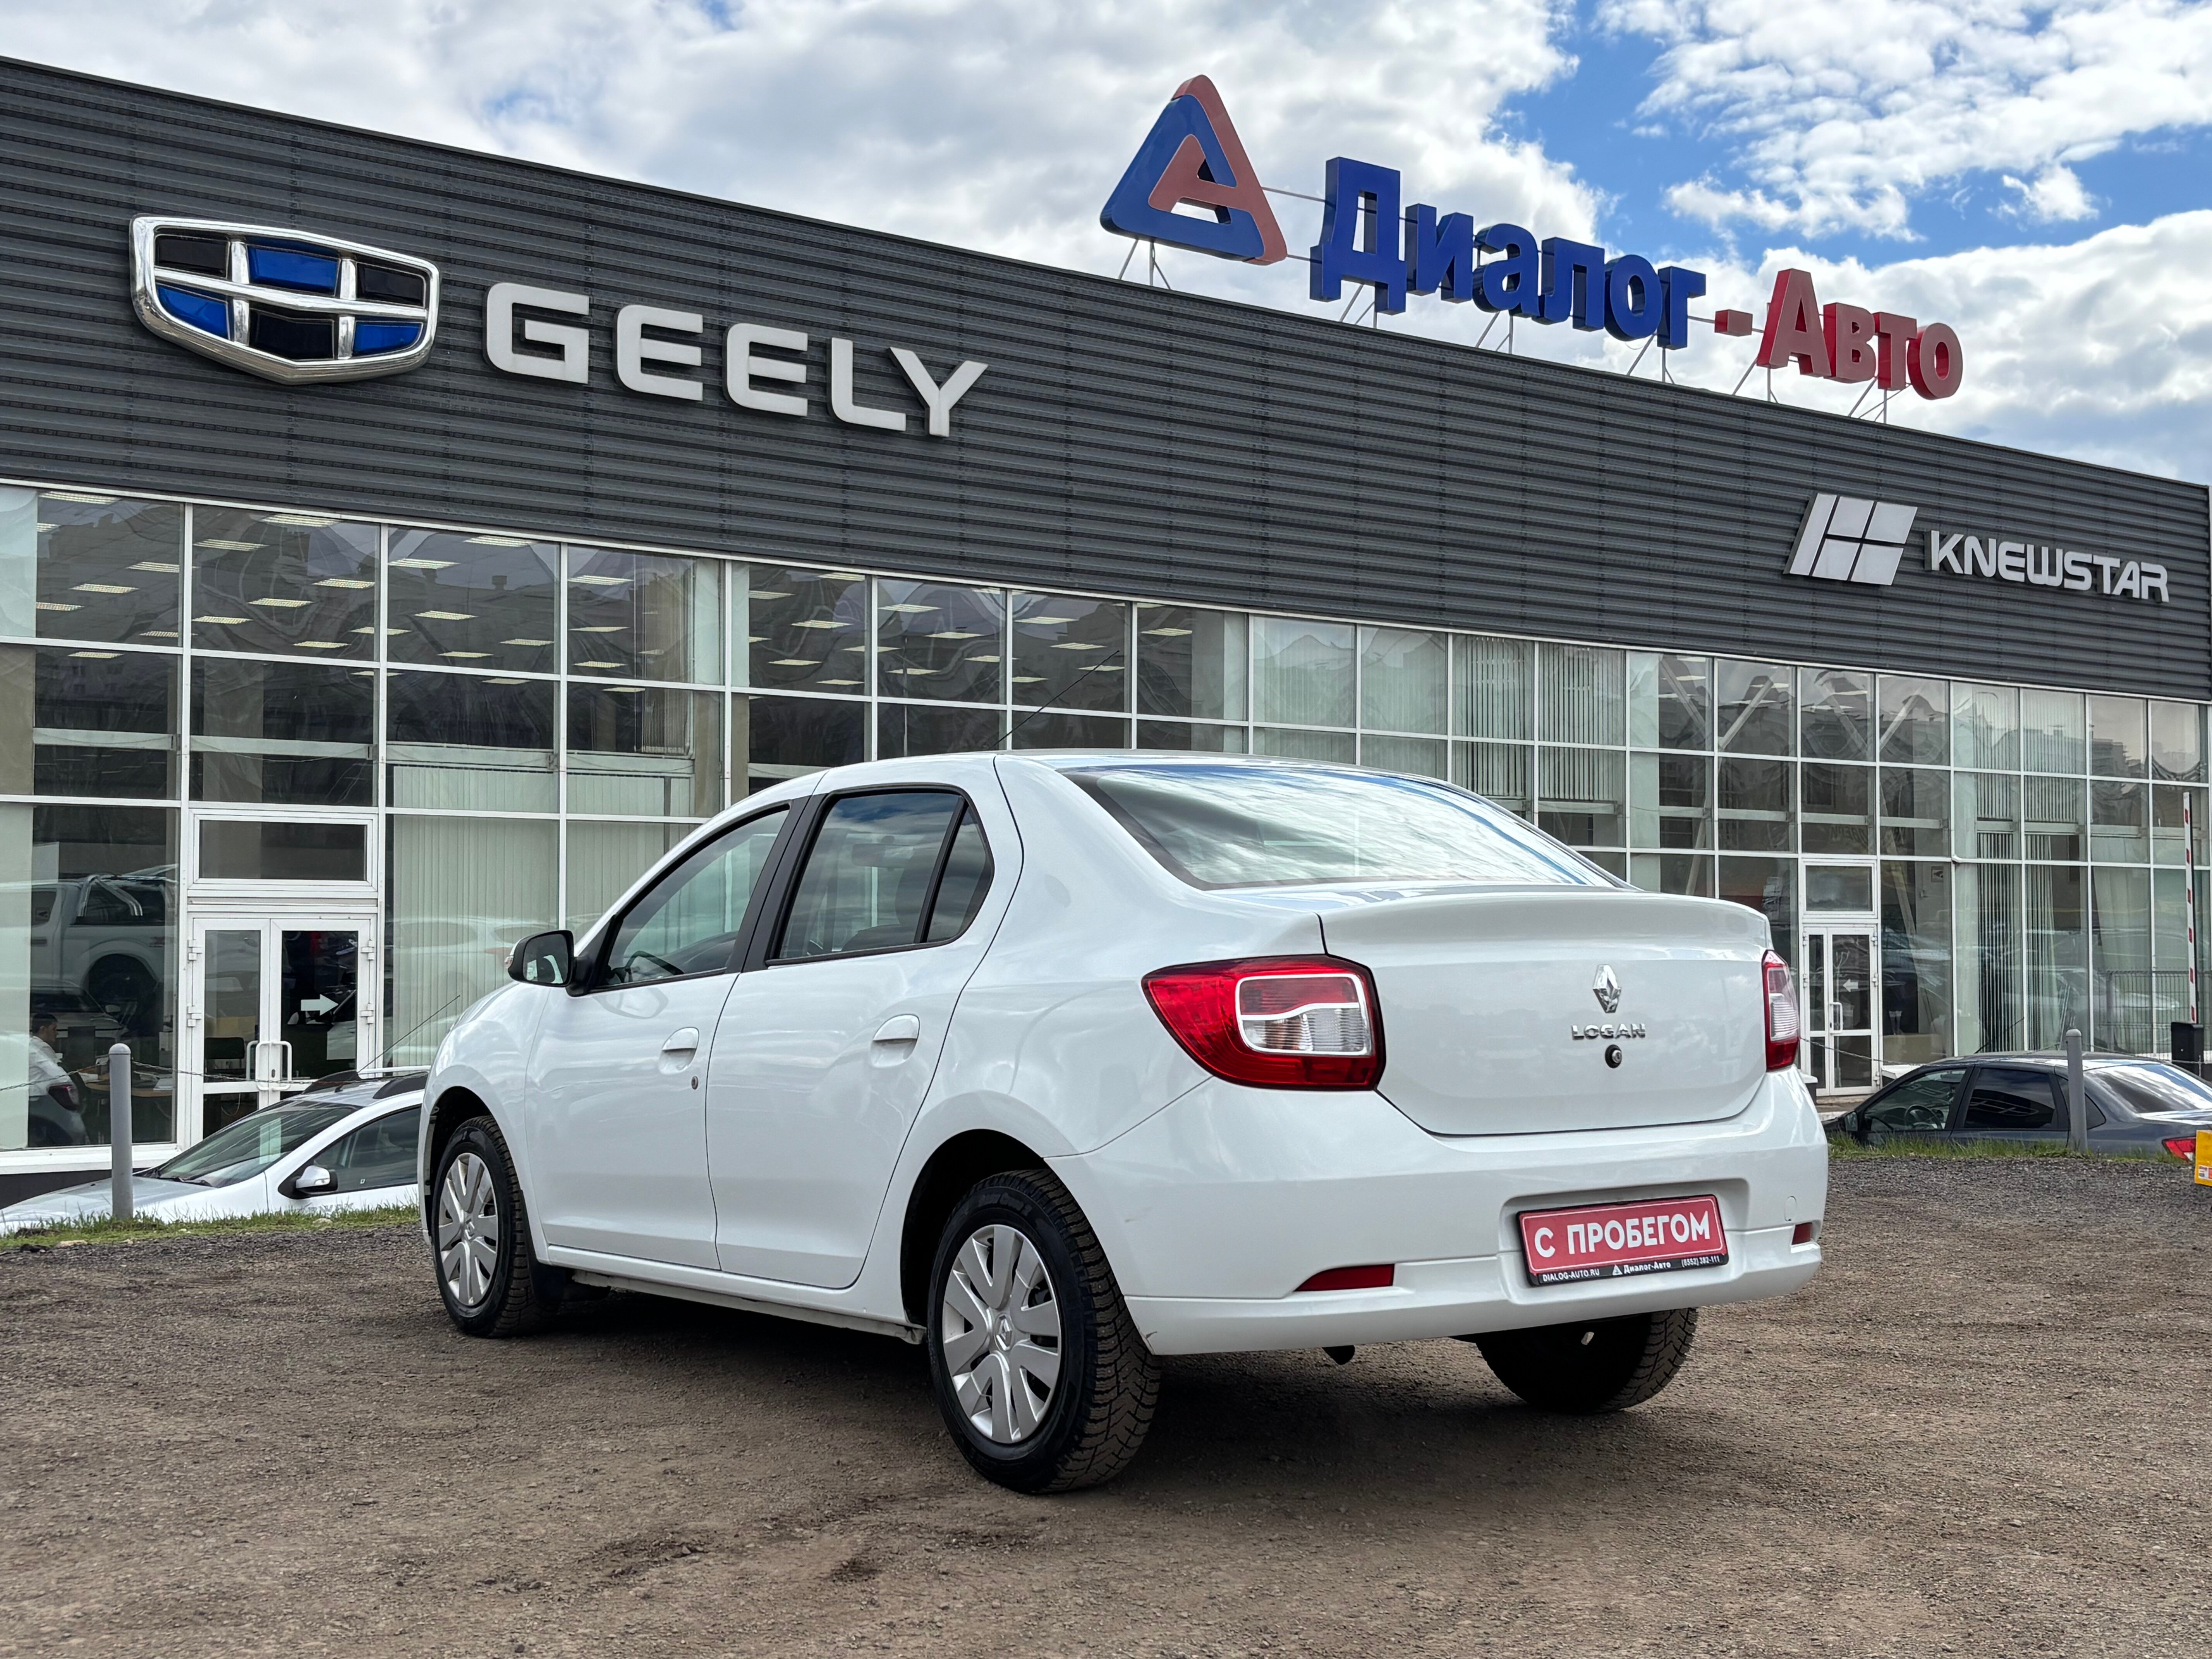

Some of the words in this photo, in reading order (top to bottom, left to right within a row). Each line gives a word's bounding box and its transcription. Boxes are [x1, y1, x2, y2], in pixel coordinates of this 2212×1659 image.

[484, 282, 989, 438] GEELY
[1928, 530, 2169, 602] KNEWSTAR
[1571, 1022, 1646, 1041] LOGAN
[1534, 1227, 1556, 1258] С
[1567, 1211, 1711, 1254] ПРОБЕГОМ
[1542, 1268, 1600, 1282] DIALOG-AUTO.RU
[1623, 1261, 1671, 1274] Диалог-Авто
